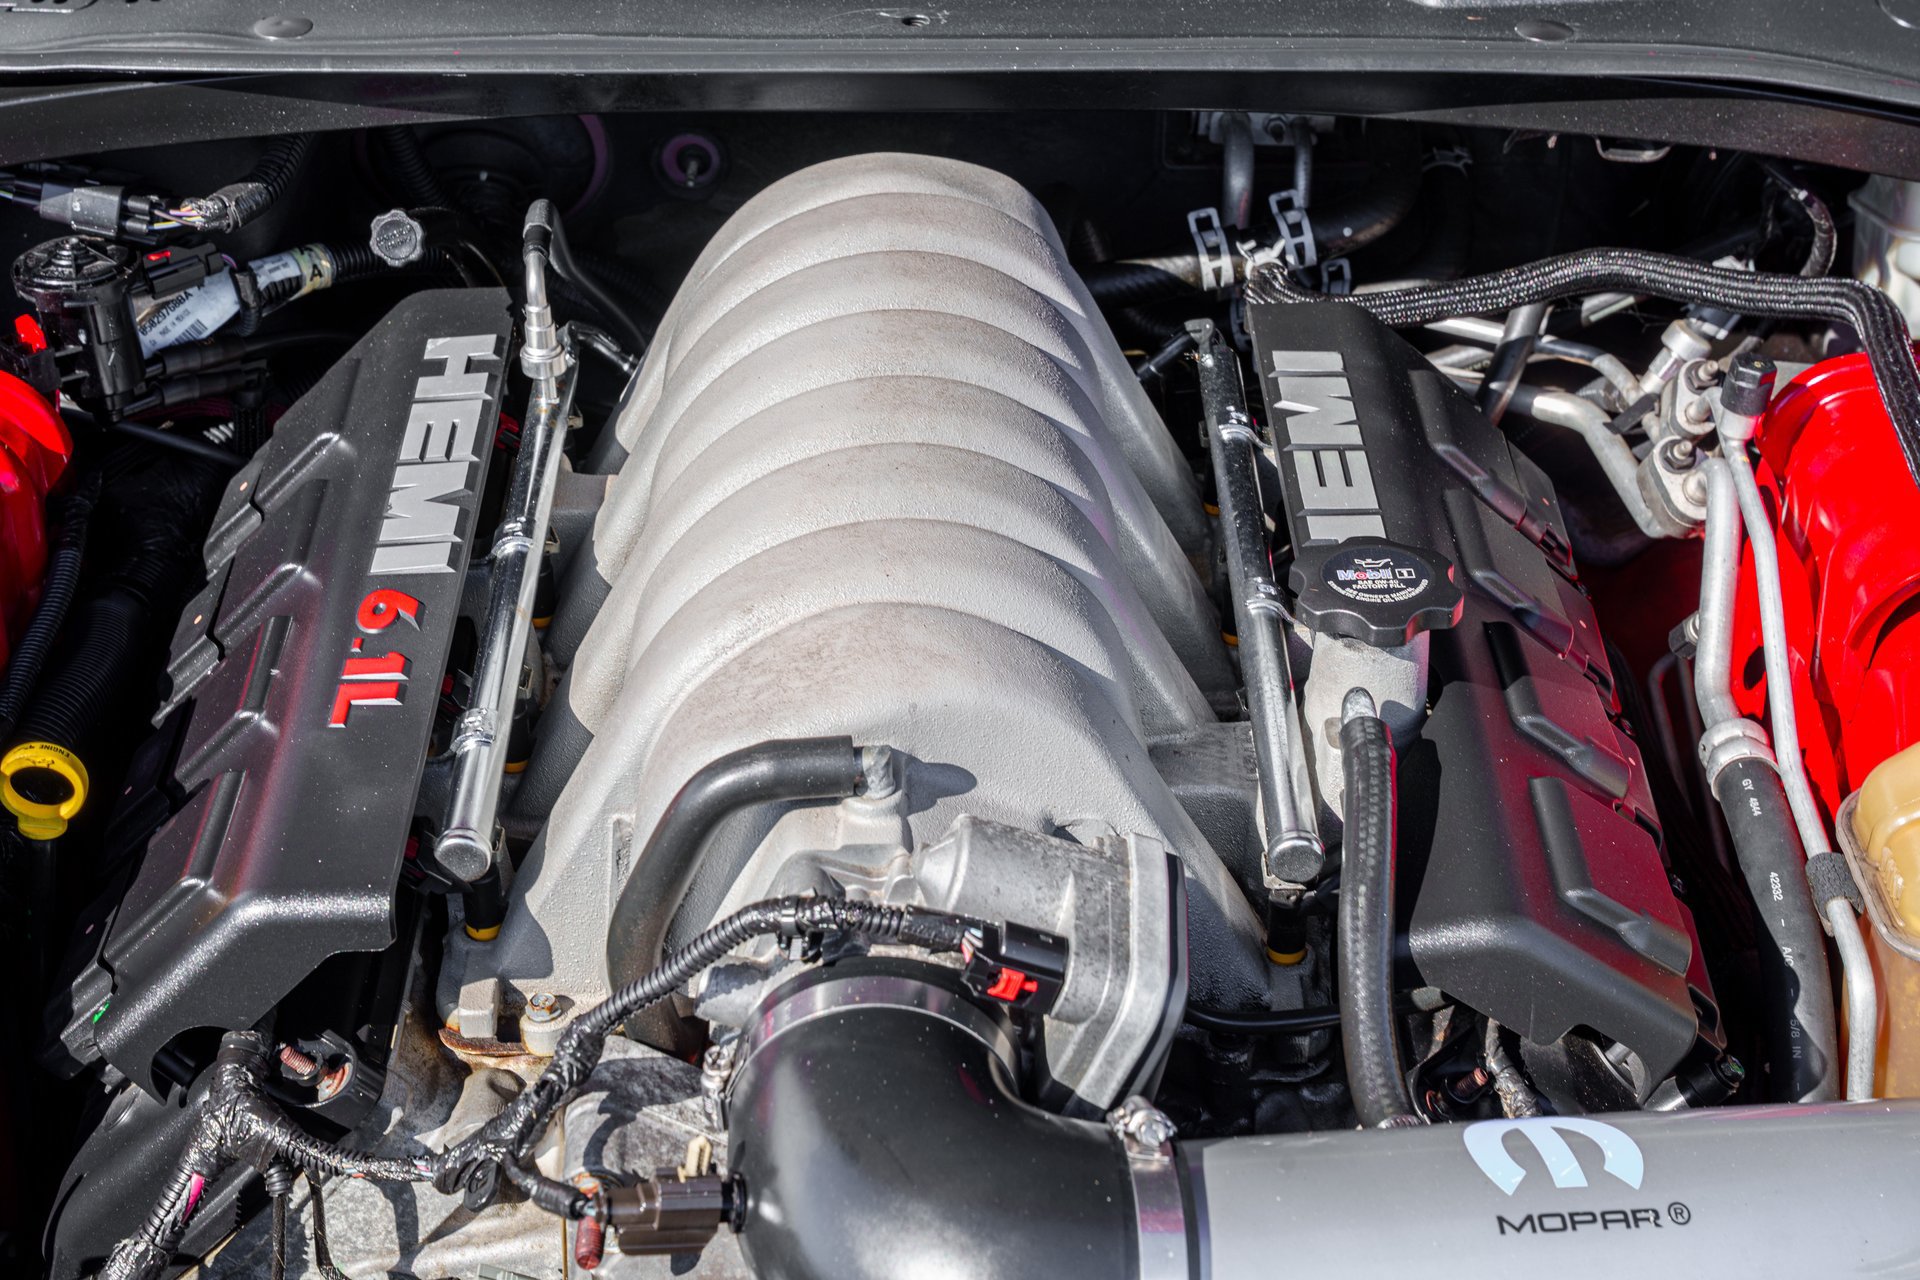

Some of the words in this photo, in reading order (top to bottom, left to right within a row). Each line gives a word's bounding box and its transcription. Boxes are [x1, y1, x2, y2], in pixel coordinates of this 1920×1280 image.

[368, 333, 499, 575] HEMI
[1336, 567, 1393, 581] Mobil
[327, 589, 425, 729] 6.1L
[39, 744, 71, 758] ENGINE
[1741, 778, 1754, 792] GY
[1768, 871, 1784, 902] 42332
[1781, 947, 1795, 968] A/C
[1789, 1018, 1802, 1039] 5/8
[1791, 1046, 1802, 1059] IN
[1496, 1208, 1663, 1236] MOPAR
